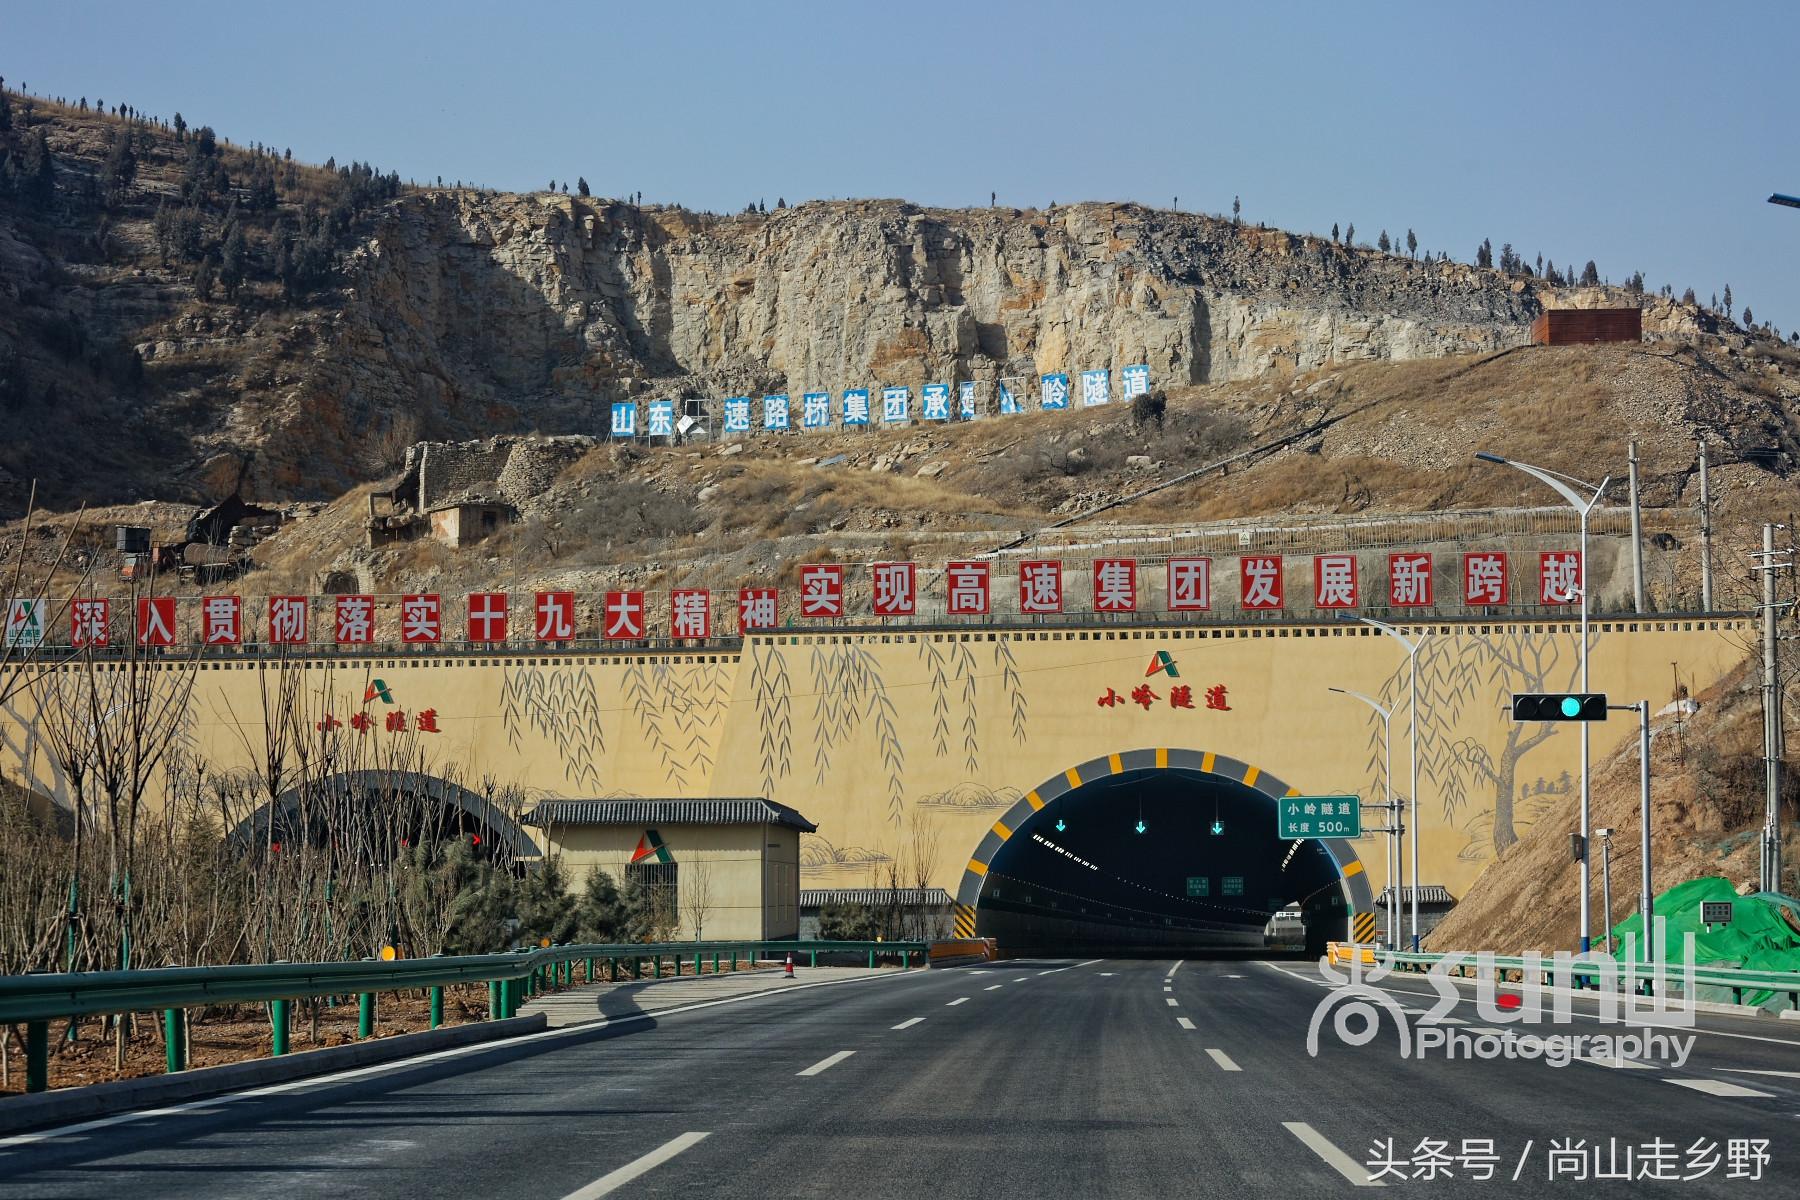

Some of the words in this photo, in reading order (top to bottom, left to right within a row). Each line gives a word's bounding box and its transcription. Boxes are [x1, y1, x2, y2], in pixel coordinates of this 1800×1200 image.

[803, 554, 1579, 613] 实现高速集团发展新跨越
[74, 591, 775, 643] 深入贯彻落实十九大精神
[1098, 684, 1232, 711] 小岭隧道
[317, 708, 441, 734] 小岭隧道
[1287, 802, 1351, 815] 小岭隧道
[1288, 822, 1310, 832] 长度
[1318, 821, 1349, 832] 500m
